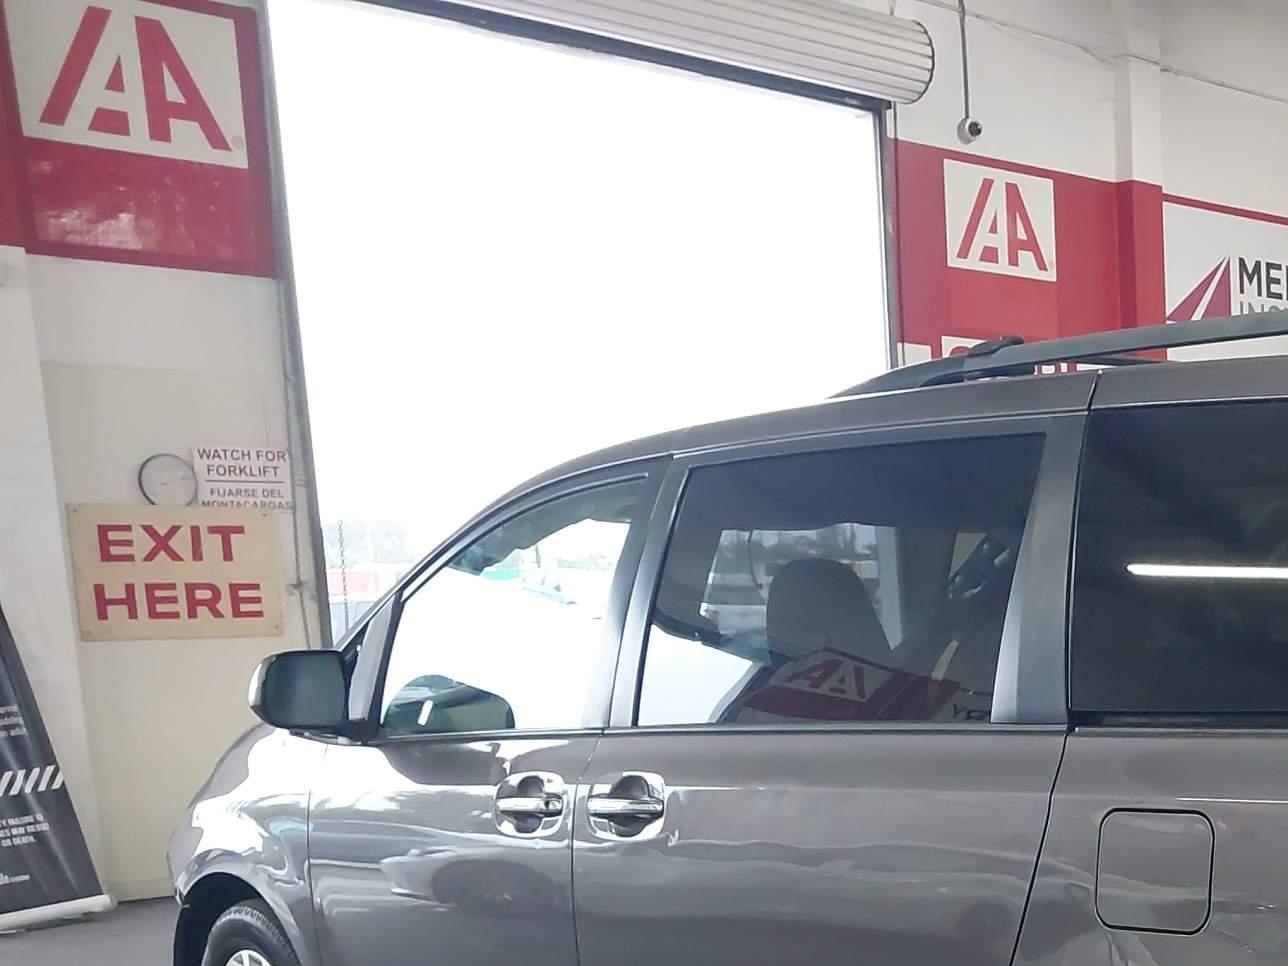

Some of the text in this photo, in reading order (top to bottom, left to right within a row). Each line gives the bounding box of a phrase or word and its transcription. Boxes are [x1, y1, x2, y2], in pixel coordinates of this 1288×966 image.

[40, 5, 233, 152] IAA
[956, 177, 1048, 272] IAA
[197, 448, 287, 462] WATCH FOR
[207, 464, 280, 478] FORKLIFT
[210, 487, 286, 499] FIJARSE DEL
[97, 524, 246, 563] EXIT
[93, 582, 265, 621] HERE
